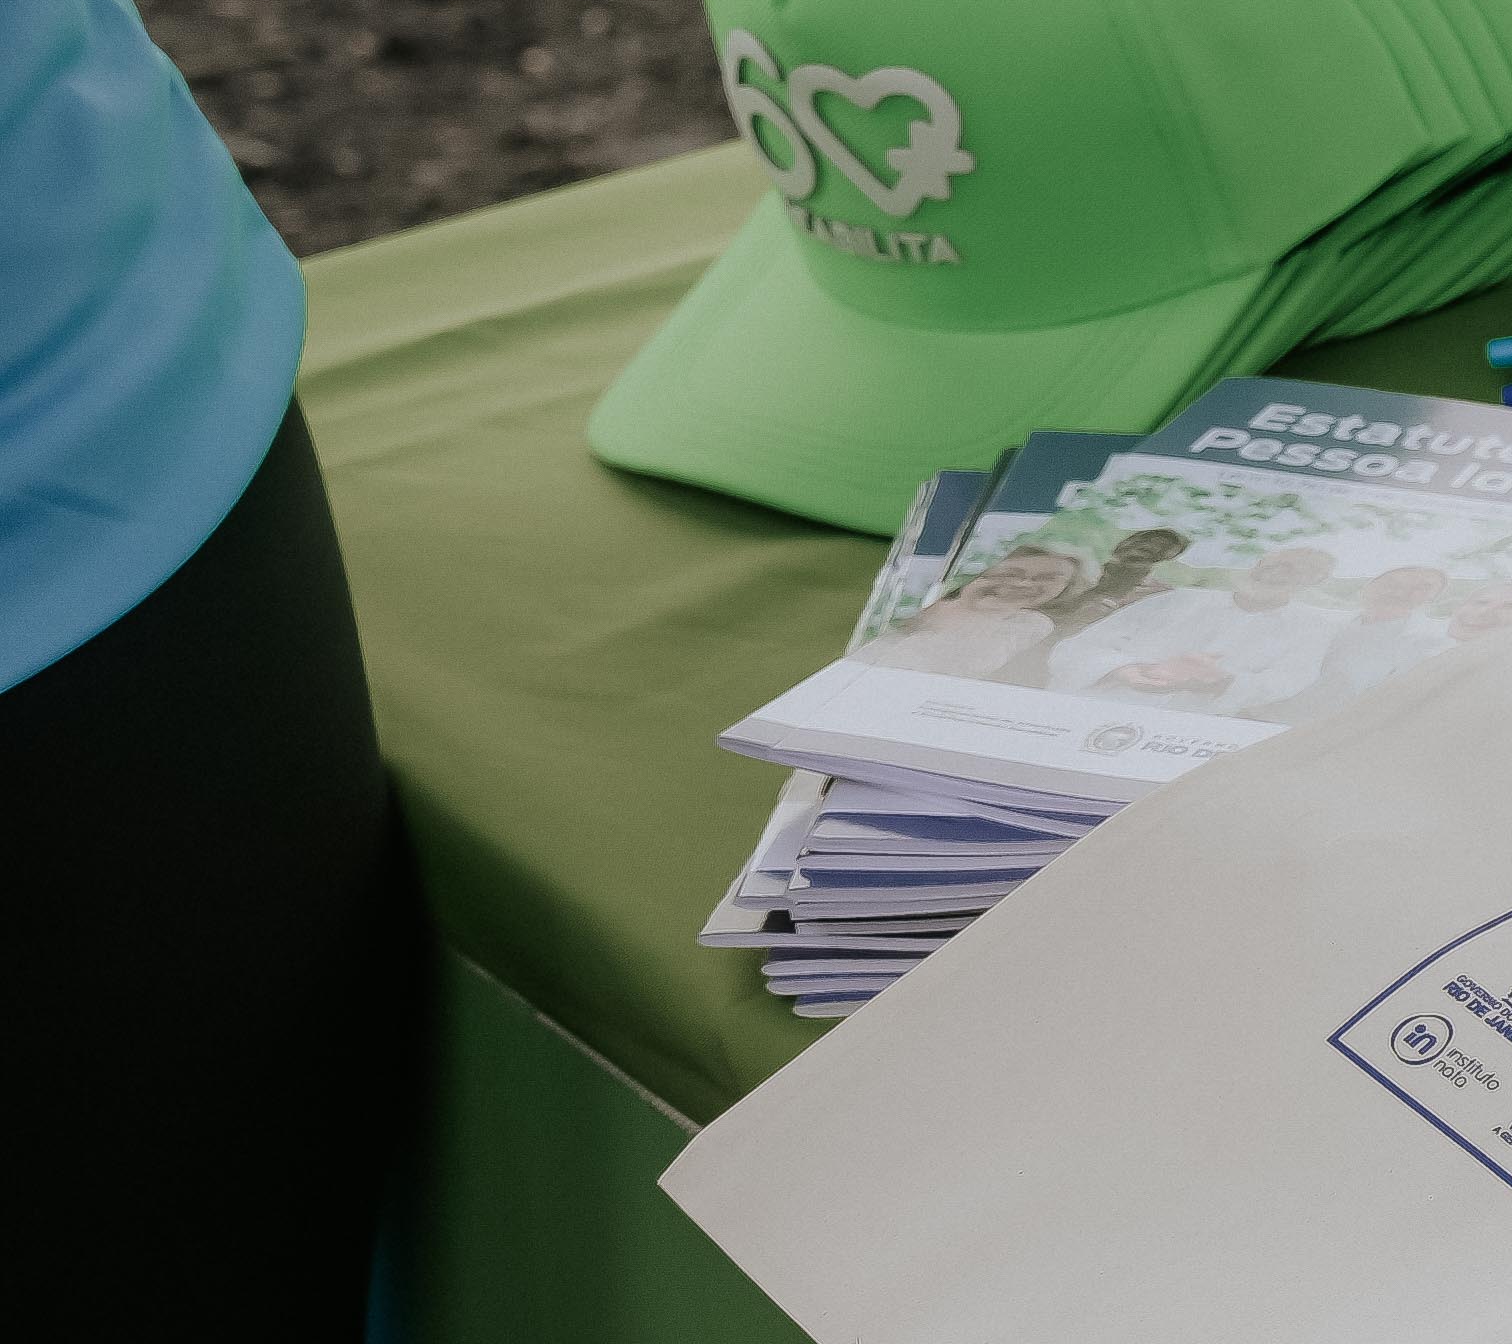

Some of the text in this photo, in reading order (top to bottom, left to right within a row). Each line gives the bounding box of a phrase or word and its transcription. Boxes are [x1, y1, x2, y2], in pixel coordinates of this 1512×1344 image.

[1189, 426, 1439, 486] Pessoa
[1443, 980, 1471, 1003] RIO
[1466, 997, 1491, 1018] DE
[1456, 974, 1502, 1010] GOVERNO
[1446, 1047, 1500, 1090] instituto
